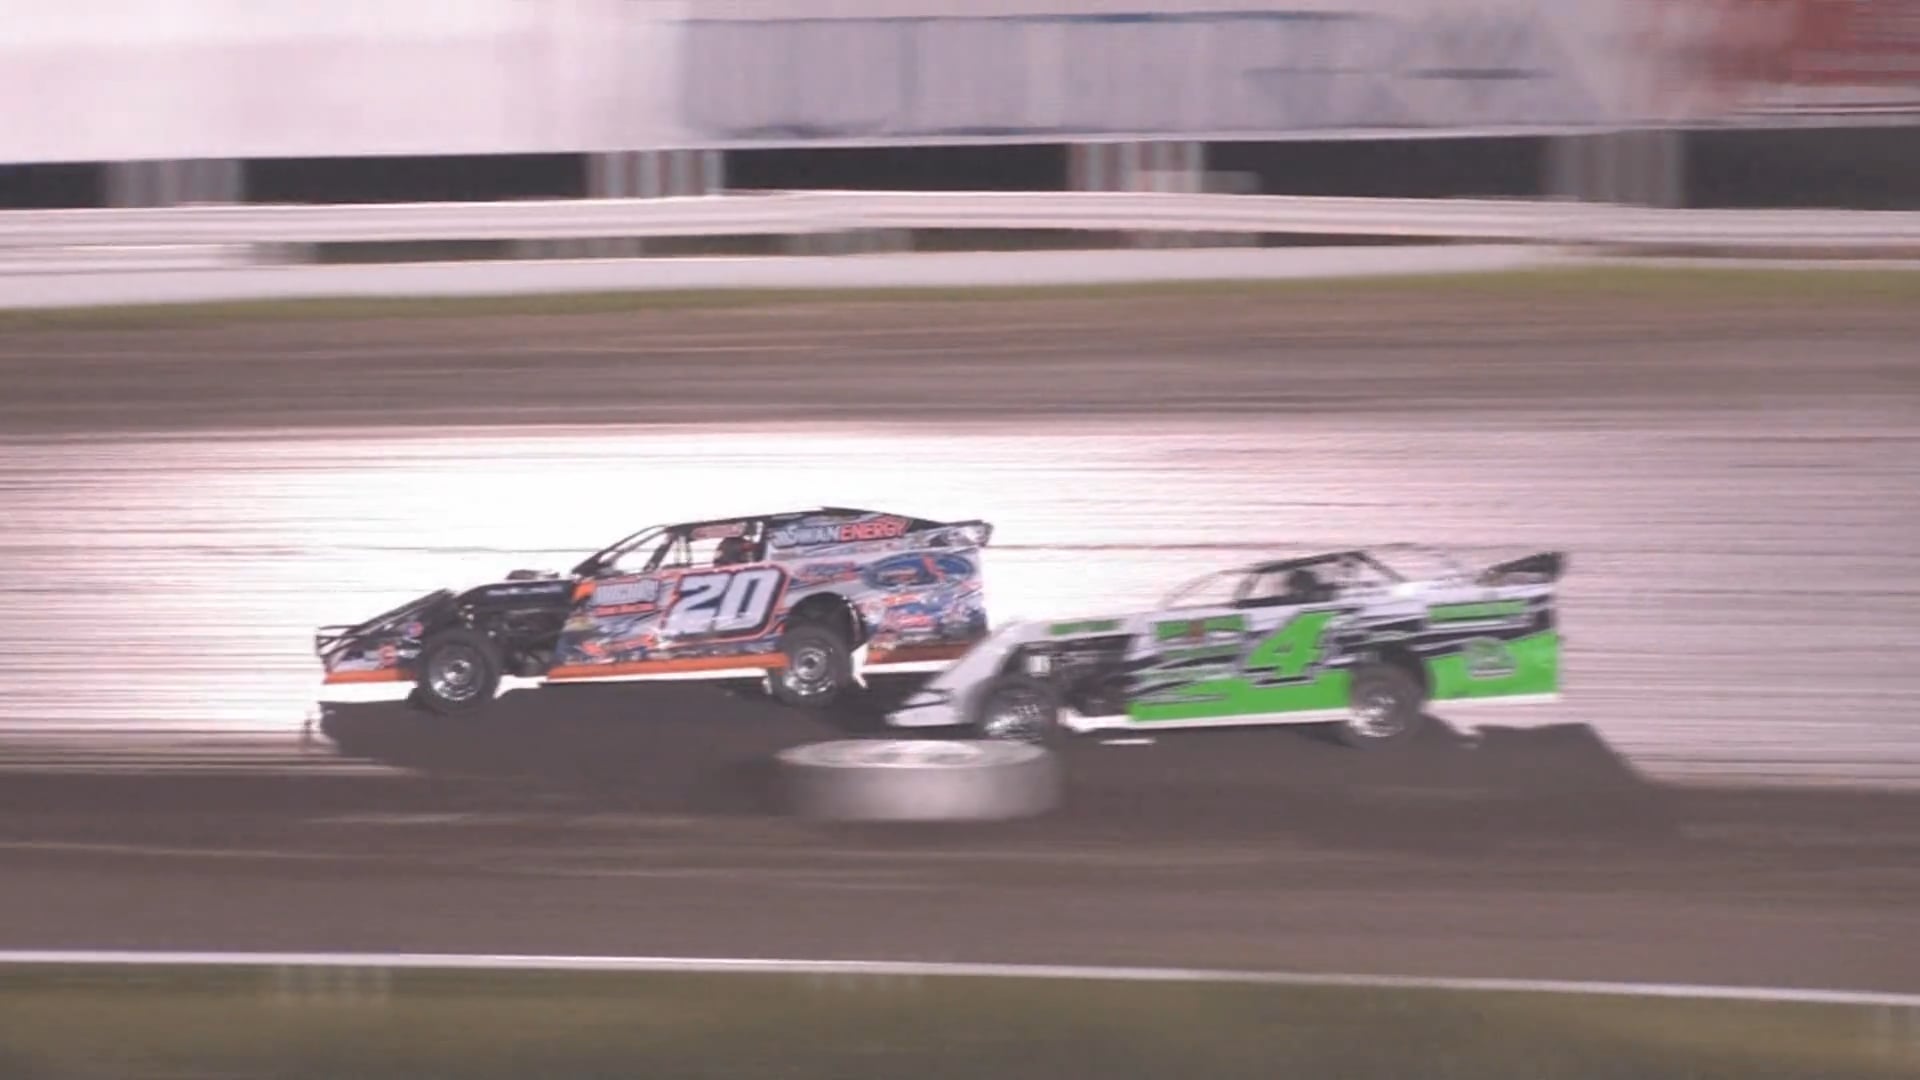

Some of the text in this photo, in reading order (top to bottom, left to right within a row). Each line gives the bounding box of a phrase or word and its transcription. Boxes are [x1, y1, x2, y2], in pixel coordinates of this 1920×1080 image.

[841, 518, 908, 542] ENERGY
[665, 567, 785, 636] 20
[1247, 609, 1339, 681] 4
